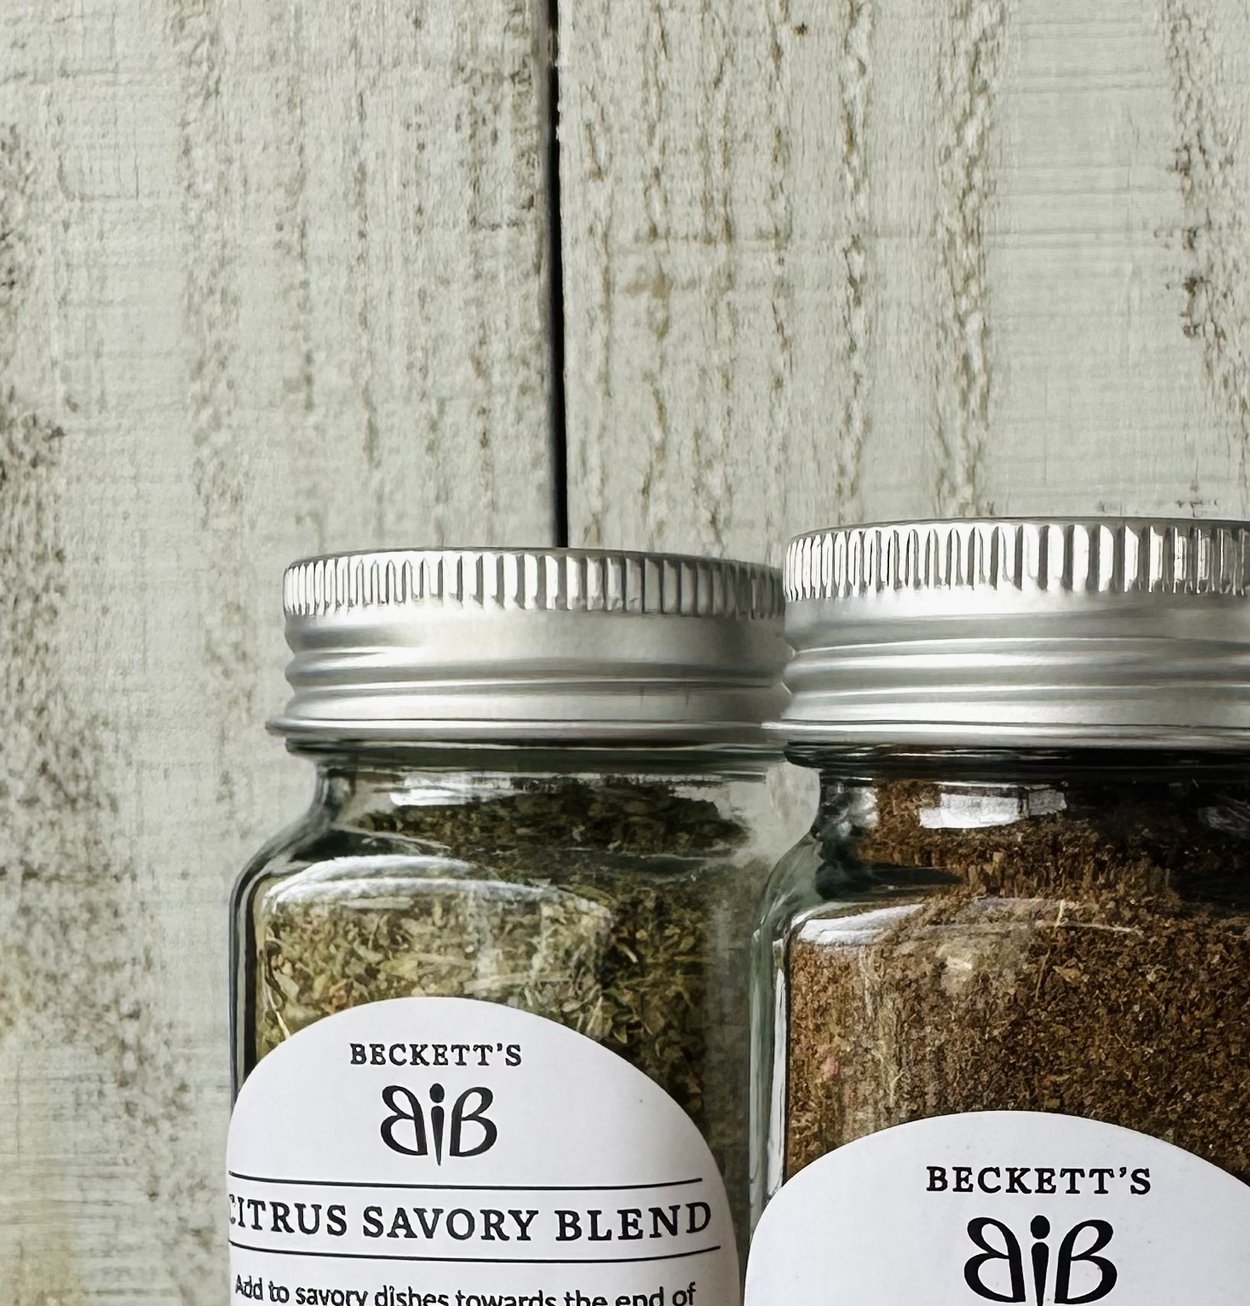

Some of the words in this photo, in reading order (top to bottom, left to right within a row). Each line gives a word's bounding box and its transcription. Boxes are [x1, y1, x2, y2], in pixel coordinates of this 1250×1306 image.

[349, 1042, 522, 1068] BECKETT'S
[925, 1165, 1152, 1196] BECKETT'S
[362, 1205, 540, 1242] SAVORY
[553, 1201, 712, 1242] BLEND
[235, 1274, 264, 1302] Add
[267, 1280, 291, 1305] to
